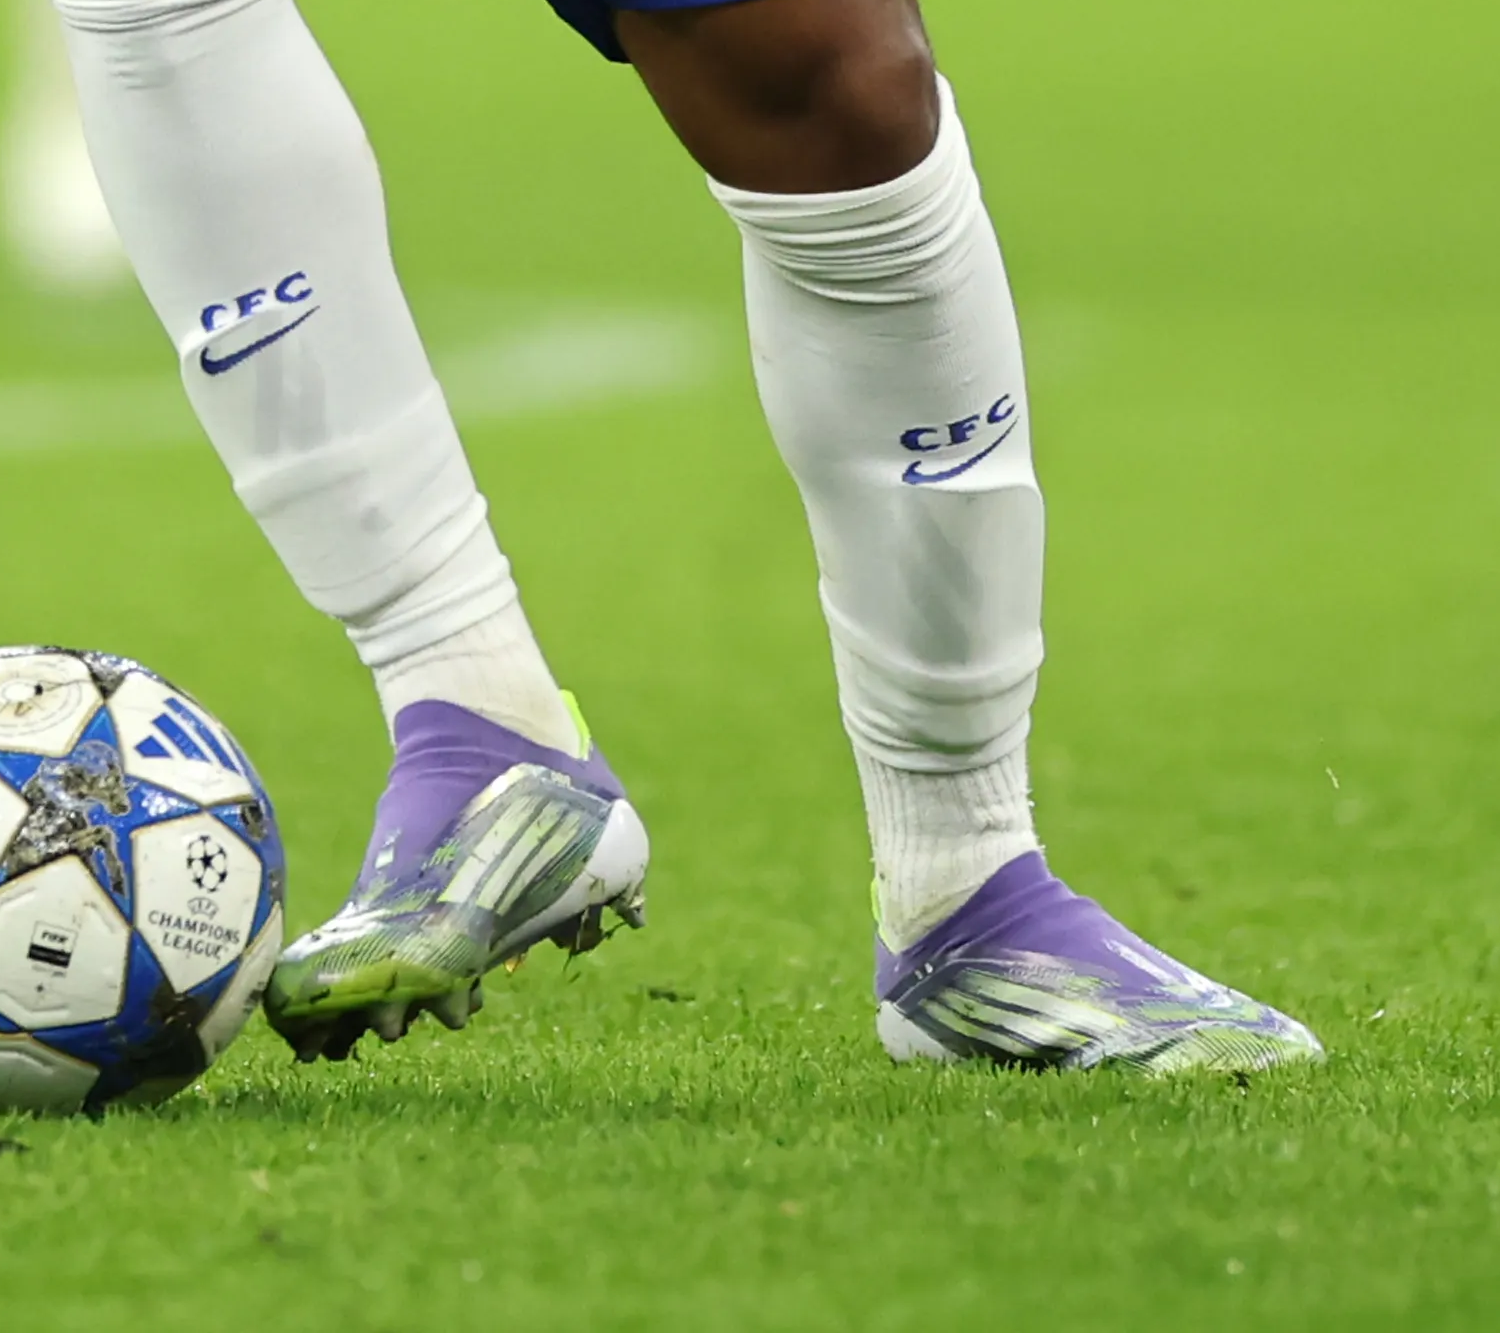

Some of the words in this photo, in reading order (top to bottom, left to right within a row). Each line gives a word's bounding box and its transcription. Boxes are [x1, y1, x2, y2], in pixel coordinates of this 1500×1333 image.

[200, 270, 313, 333] CFC
[899, 393, 1016, 452] CFC
[147, 910, 241, 945] CHAMPIONS
